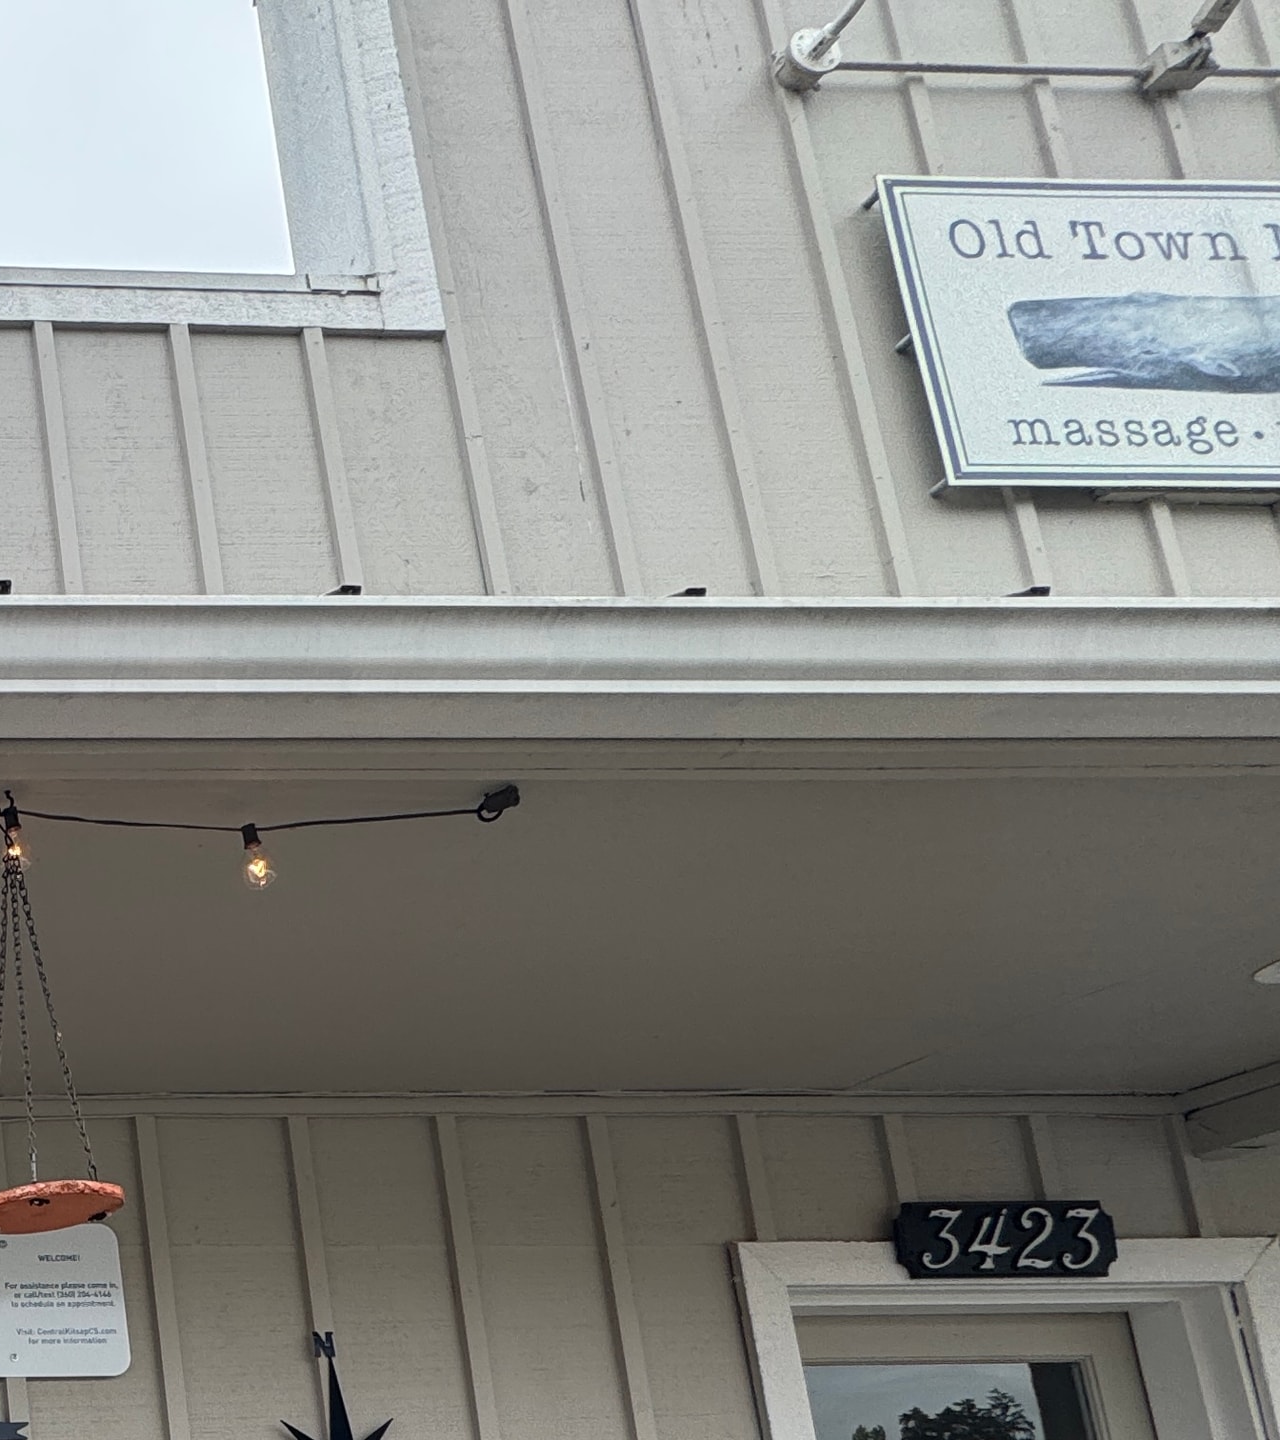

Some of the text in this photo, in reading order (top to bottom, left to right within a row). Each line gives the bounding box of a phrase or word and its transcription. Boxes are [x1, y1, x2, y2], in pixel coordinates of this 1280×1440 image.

[948, 218, 1052, 260] Old
[1069, 219, 1249, 262] Town
[1007, 416, 1239, 455] massage
[922, 1206, 1100, 1270] 3423
[37, 1254, 80, 1262] WELCOME!
[312, 1331, 336, 1358] N
